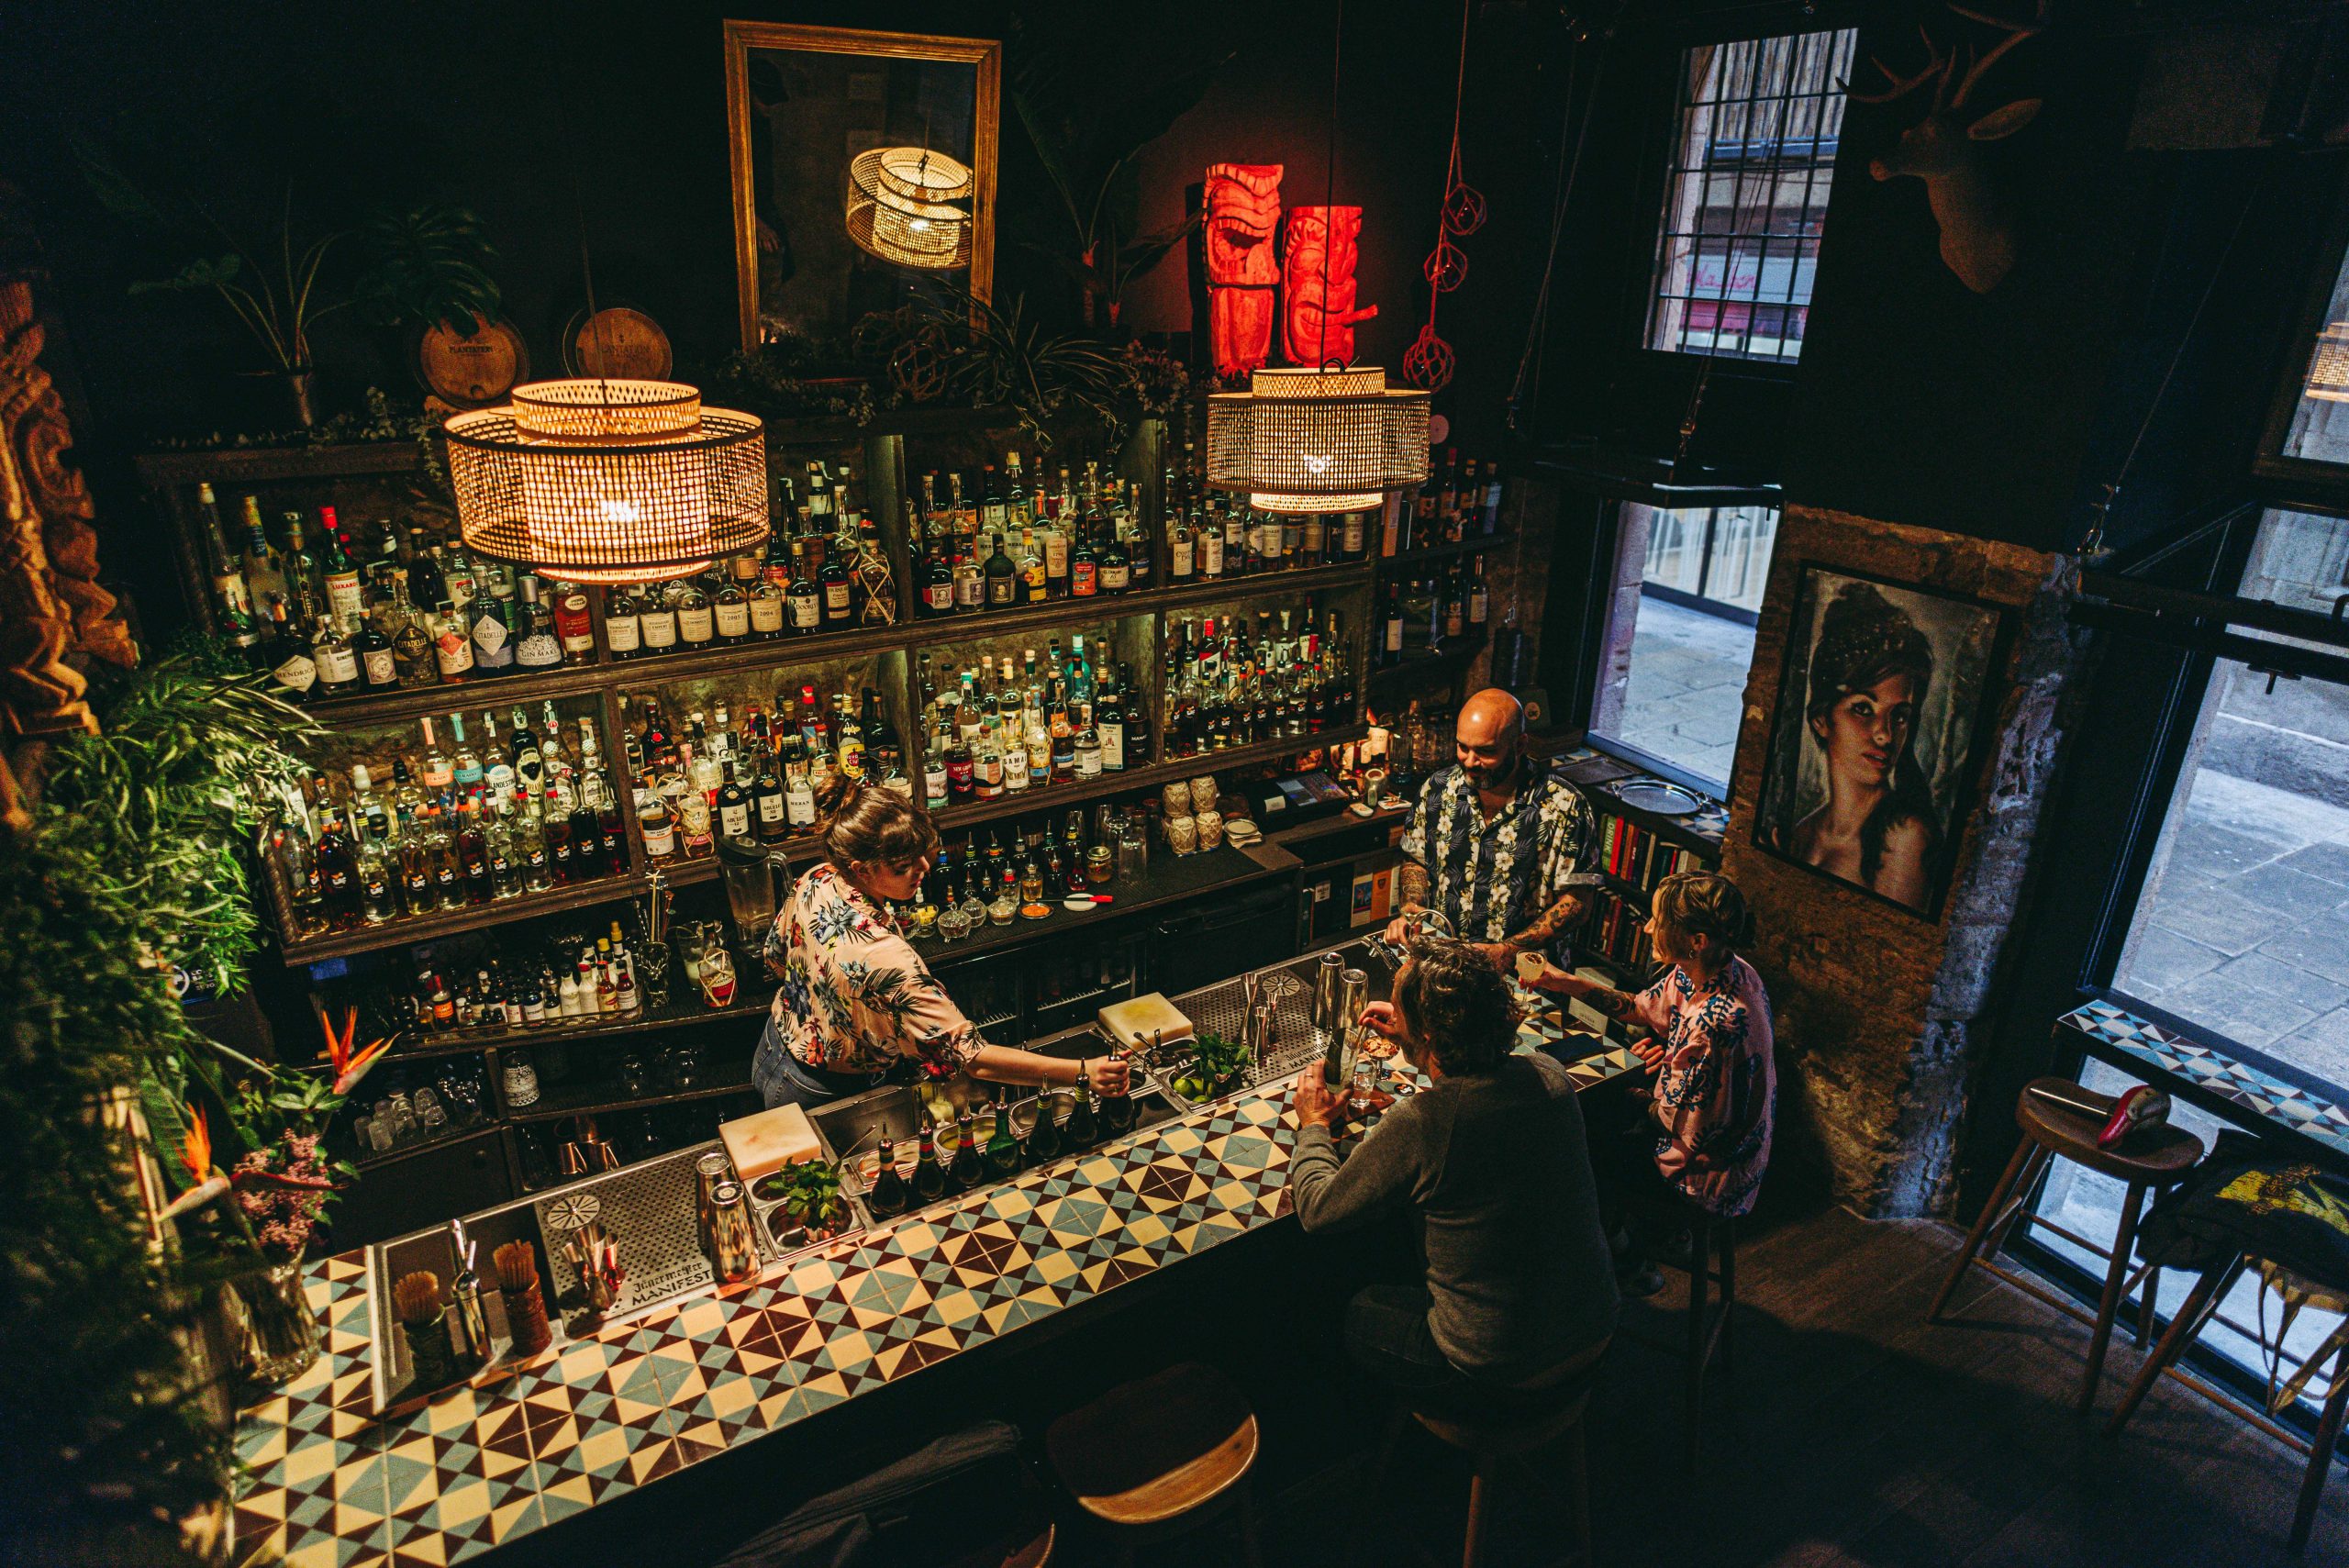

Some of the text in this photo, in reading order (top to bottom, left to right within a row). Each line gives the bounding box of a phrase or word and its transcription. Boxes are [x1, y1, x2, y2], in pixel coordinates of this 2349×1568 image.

[1003, 756, 1027, 765] SAMAI
[1603, 822, 1615, 854] DRINK
[1288, 1049, 1327, 1070] MANIFE
[631, 1269, 712, 1306] MANIFEST
